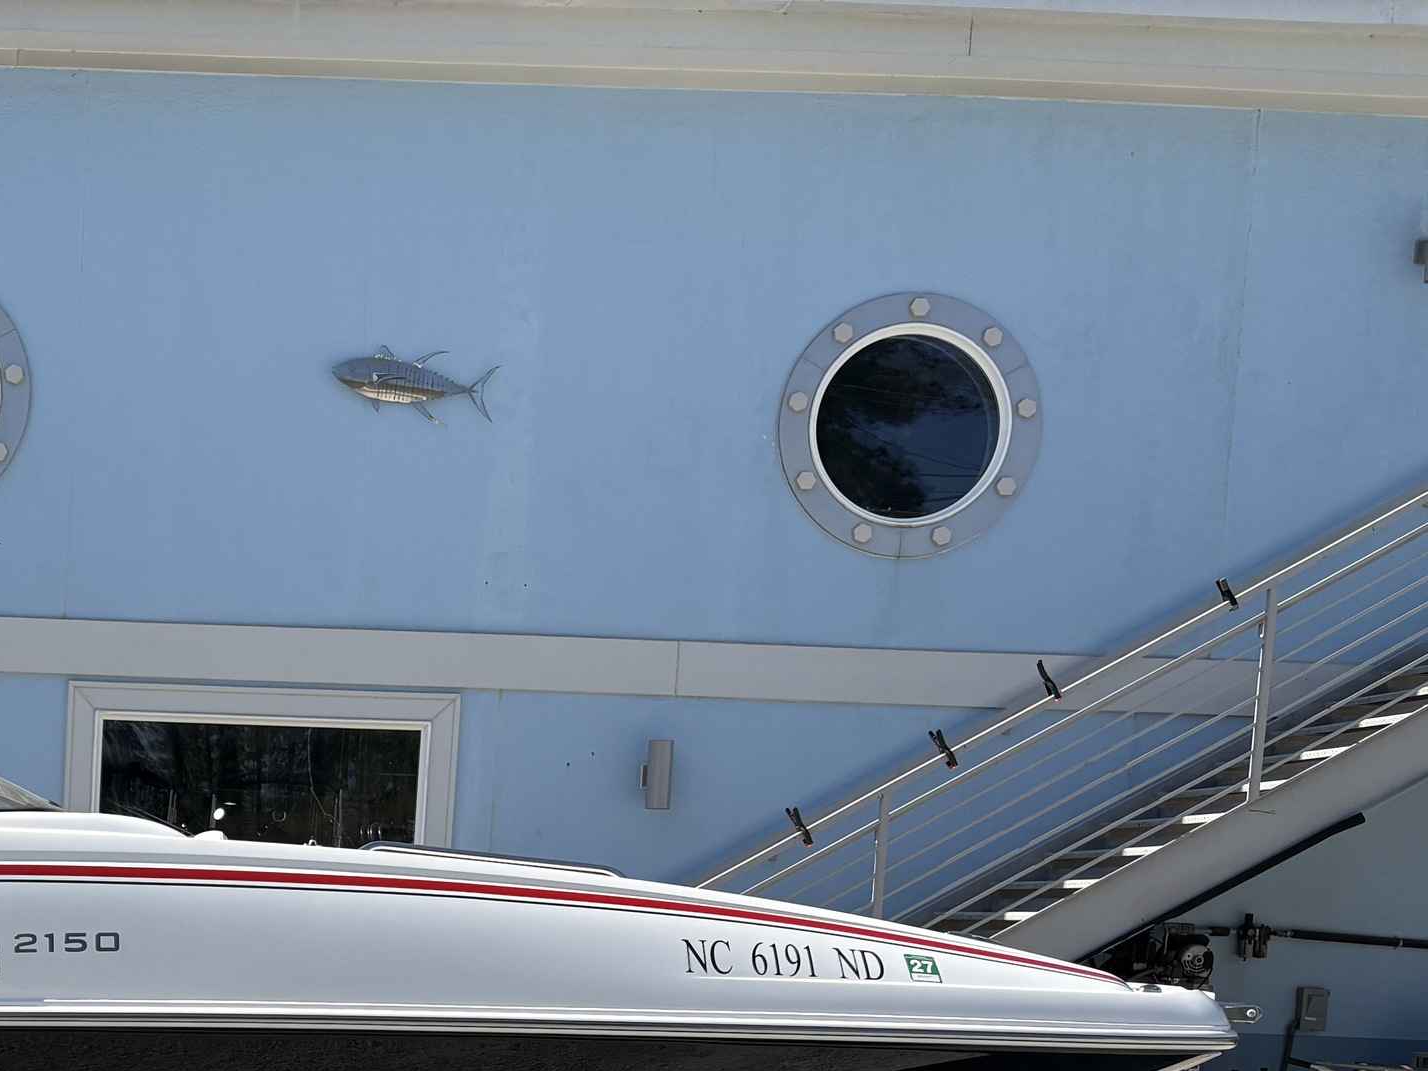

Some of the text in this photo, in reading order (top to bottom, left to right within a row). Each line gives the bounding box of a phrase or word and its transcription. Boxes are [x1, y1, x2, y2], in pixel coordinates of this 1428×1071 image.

[13, 931, 121, 954] 2150
[681, 938, 885, 981] NC 6191 ND
[909, 959, 933, 974] 27
